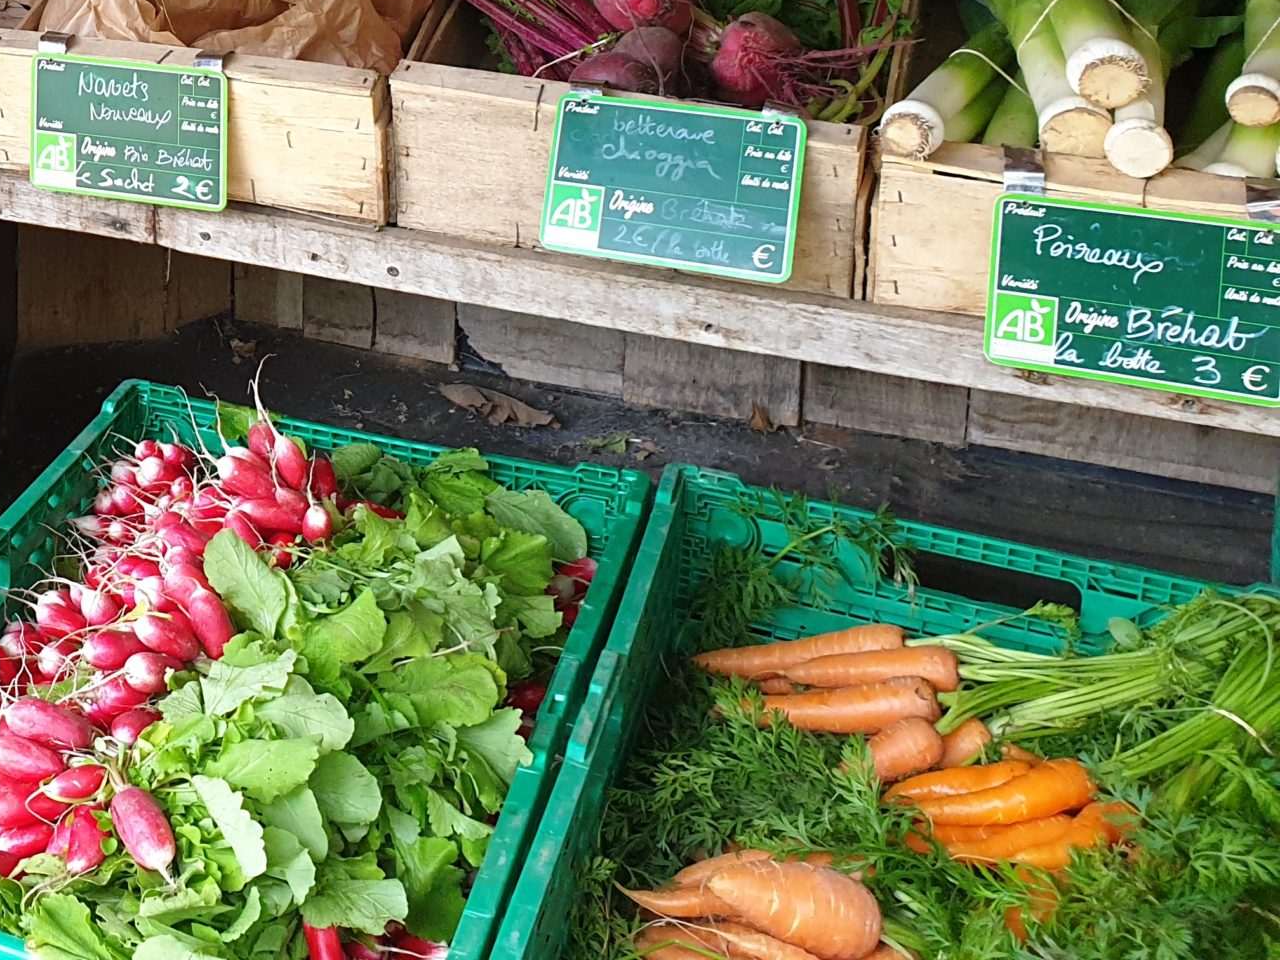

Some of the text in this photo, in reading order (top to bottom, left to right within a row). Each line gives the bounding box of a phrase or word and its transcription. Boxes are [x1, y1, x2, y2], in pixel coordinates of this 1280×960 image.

[37, 142, 70, 170] AB
[81, 137, 116, 161] Origine
[550, 197, 593, 229] AB
[608, 190, 654, 220] Origine
[1004, 204, 1046, 218] Produit
[751, 243, 776, 268] €
[1033, 224, 1163, 284] Poireaux
[996, 309, 1045, 342] AB
[1065, 302, 1119, 334] Origine
[1054, 332, 1270, 390] la botte 3 €
